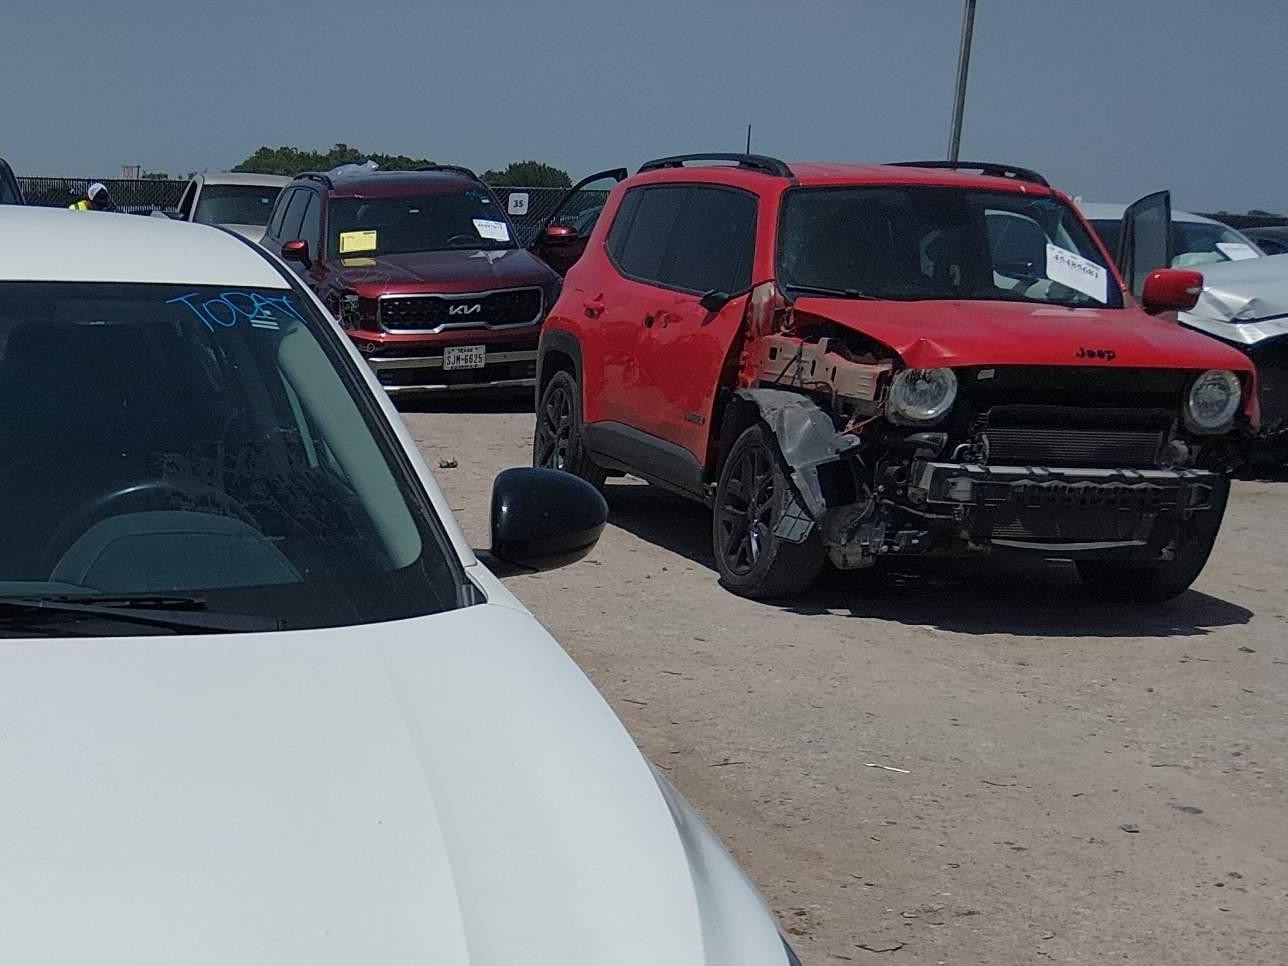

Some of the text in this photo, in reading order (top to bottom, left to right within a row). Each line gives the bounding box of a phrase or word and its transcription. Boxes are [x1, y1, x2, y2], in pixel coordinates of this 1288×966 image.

[513, 200, 524, 208] 35
[449, 304, 481, 315] KIA
[1075, 346, 1116, 361] Jeep
